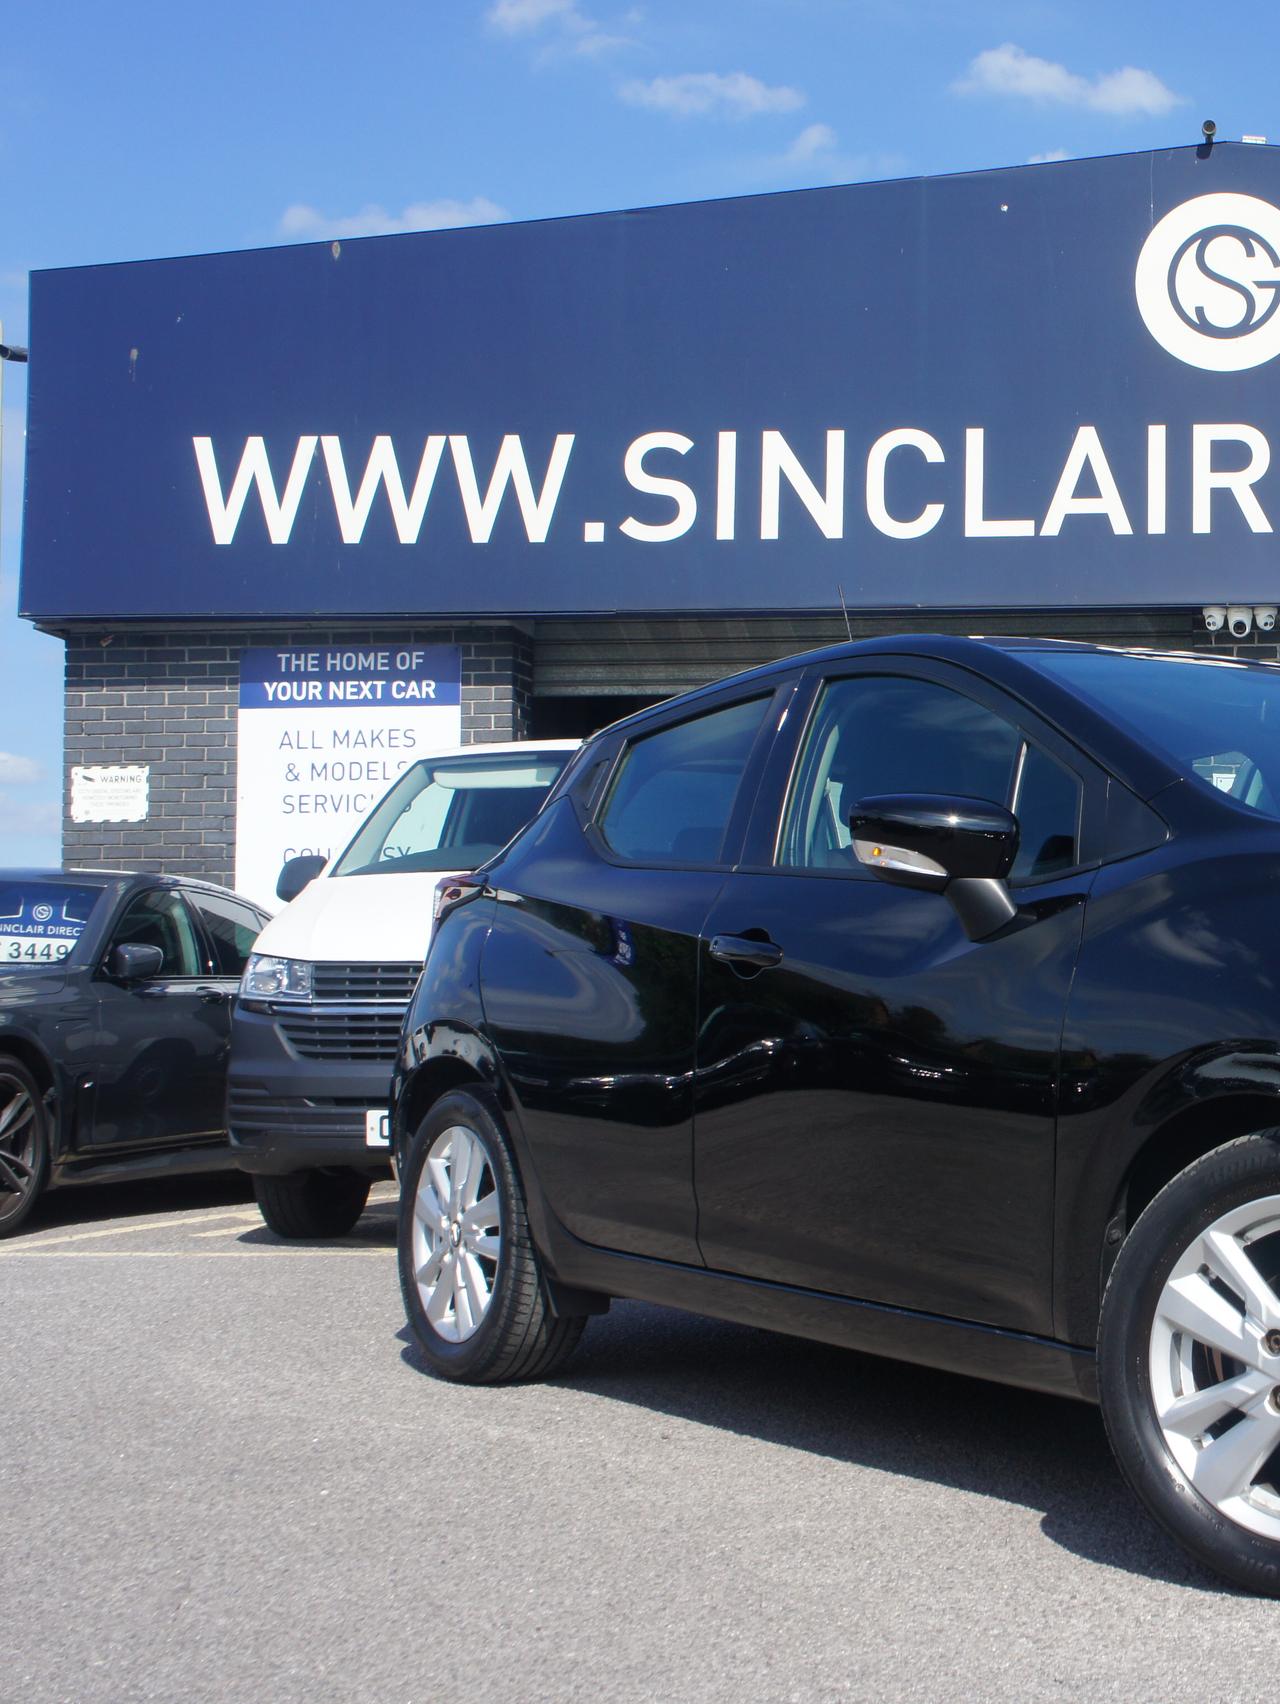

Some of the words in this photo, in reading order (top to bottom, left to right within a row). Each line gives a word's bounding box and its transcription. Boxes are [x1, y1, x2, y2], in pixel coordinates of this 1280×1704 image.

[277, 653, 320, 672] THE
[327, 652, 389, 671] HOME
[396, 651, 424, 671] OF
[264, 681, 322, 701] YOUR
[329, 680, 386, 700] NEXT
[391, 679, 436, 699] CAR
[279, 730, 323, 750] ALL
[333, 729, 416, 749] MAKES
[100, 775, 142, 783] WARNING
[285, 762, 300, 782] &
[0, 924, 44, 934] INCLAIR
